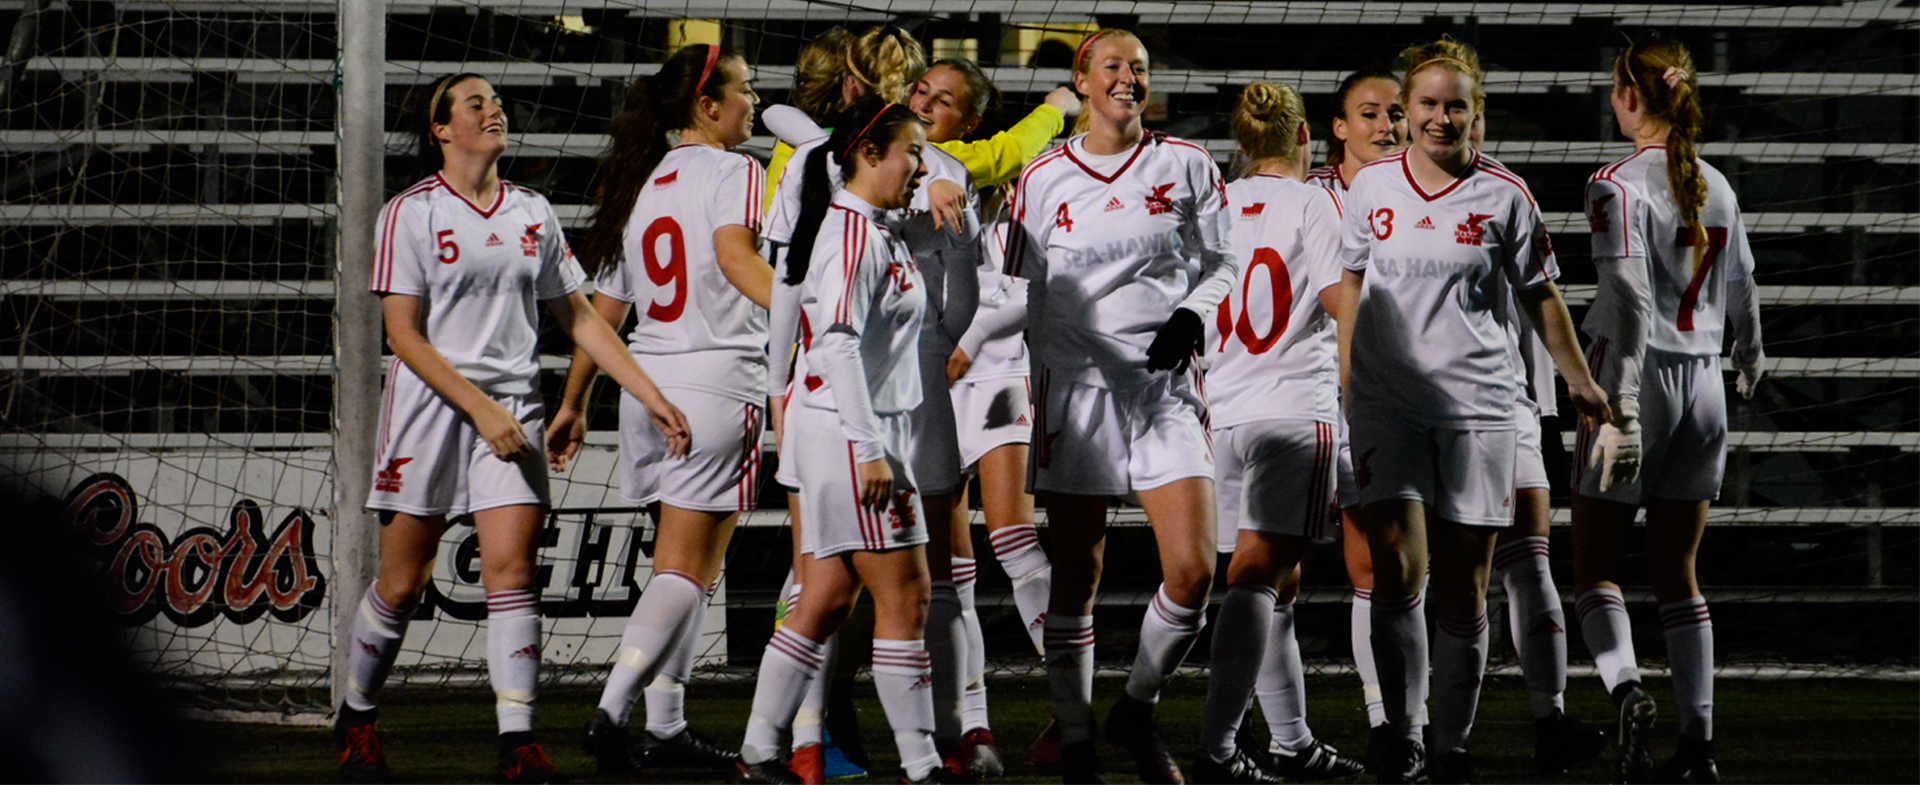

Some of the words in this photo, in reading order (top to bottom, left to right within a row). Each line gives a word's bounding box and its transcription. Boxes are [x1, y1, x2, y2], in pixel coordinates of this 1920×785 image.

[437, 229, 460, 265] 5
[1056, 202, 1073, 233] 4
[1367, 208, 1395, 241] 13
[642, 216, 687, 323] 9
[1675, 227, 1728, 332] 7
[66, 474, 319, 617] Coors
